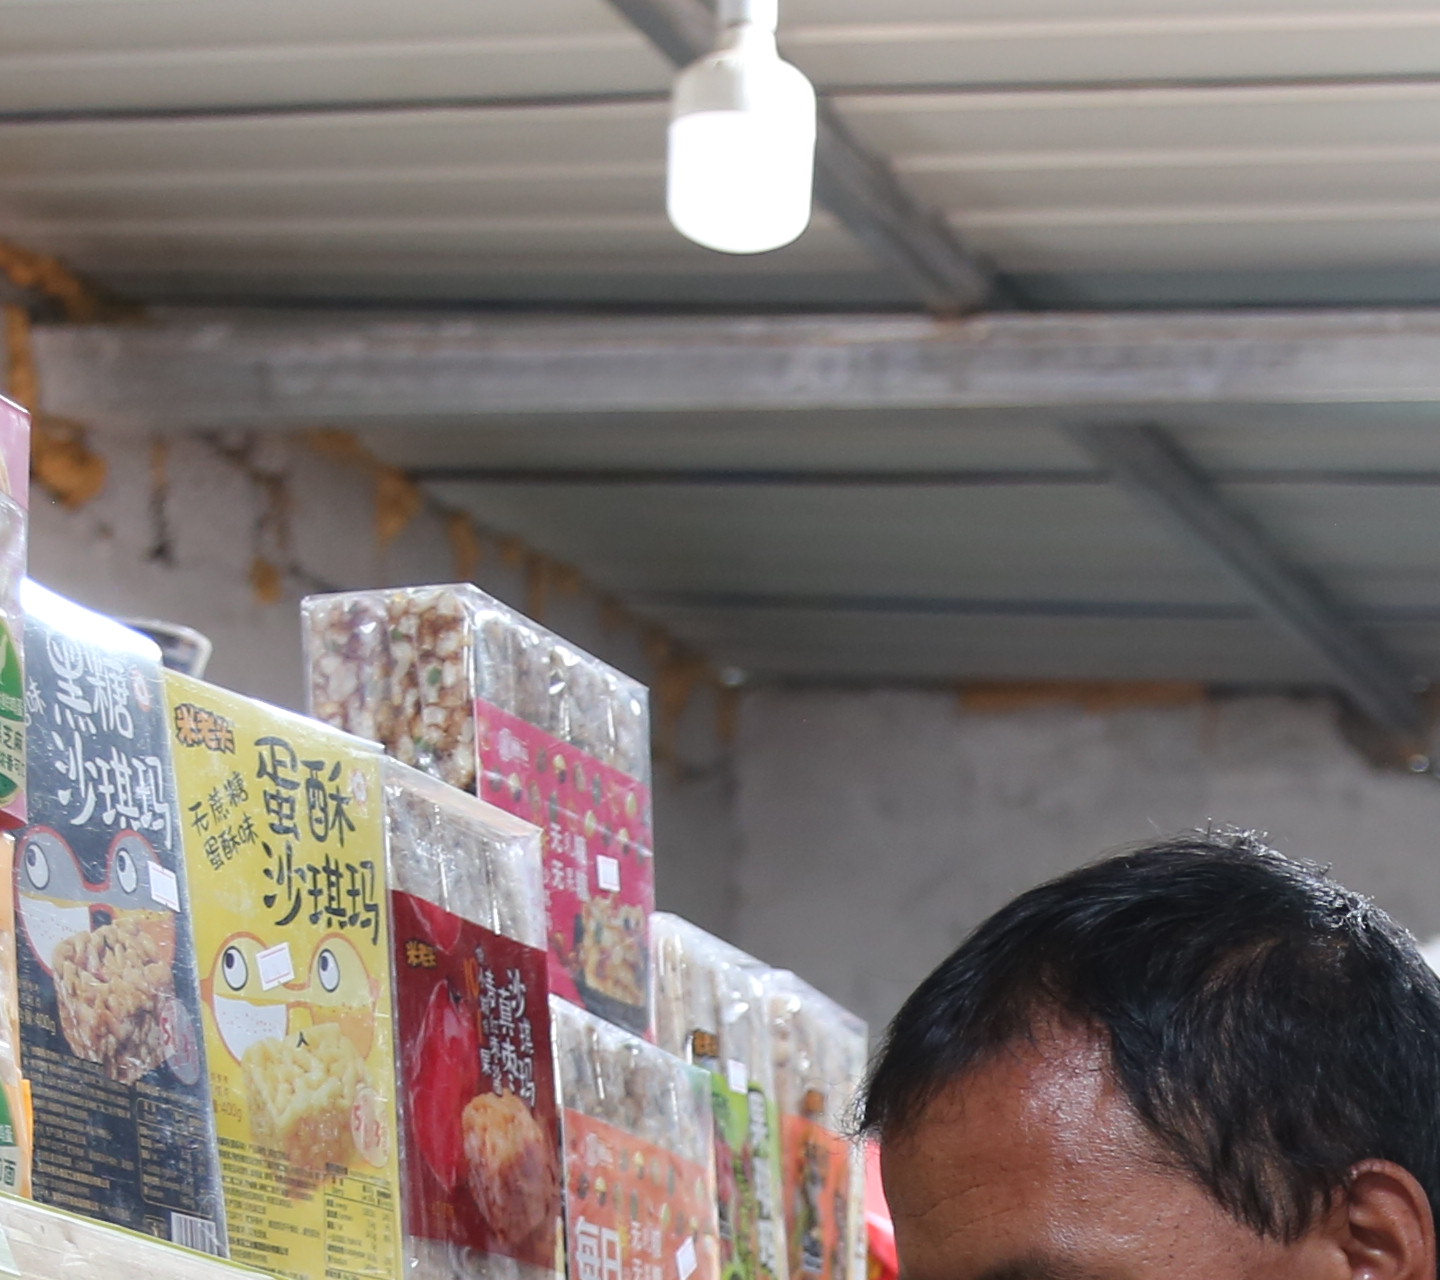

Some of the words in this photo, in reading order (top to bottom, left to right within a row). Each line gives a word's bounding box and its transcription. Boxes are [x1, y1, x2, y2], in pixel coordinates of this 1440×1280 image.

[46, 632, 135, 739] 黑糖
[174, 703, 237, 755] 米老头
[52, 731, 173, 850] 沙琪玛
[188, 771, 250, 836] 无蔗糖
[205, 812, 260, 870] 蛋酥味
[254, 737, 356, 847] 蛋酥
[262, 840, 379, 946] 沙琪玛
[508, 969, 535, 1108] 沙琪玛
